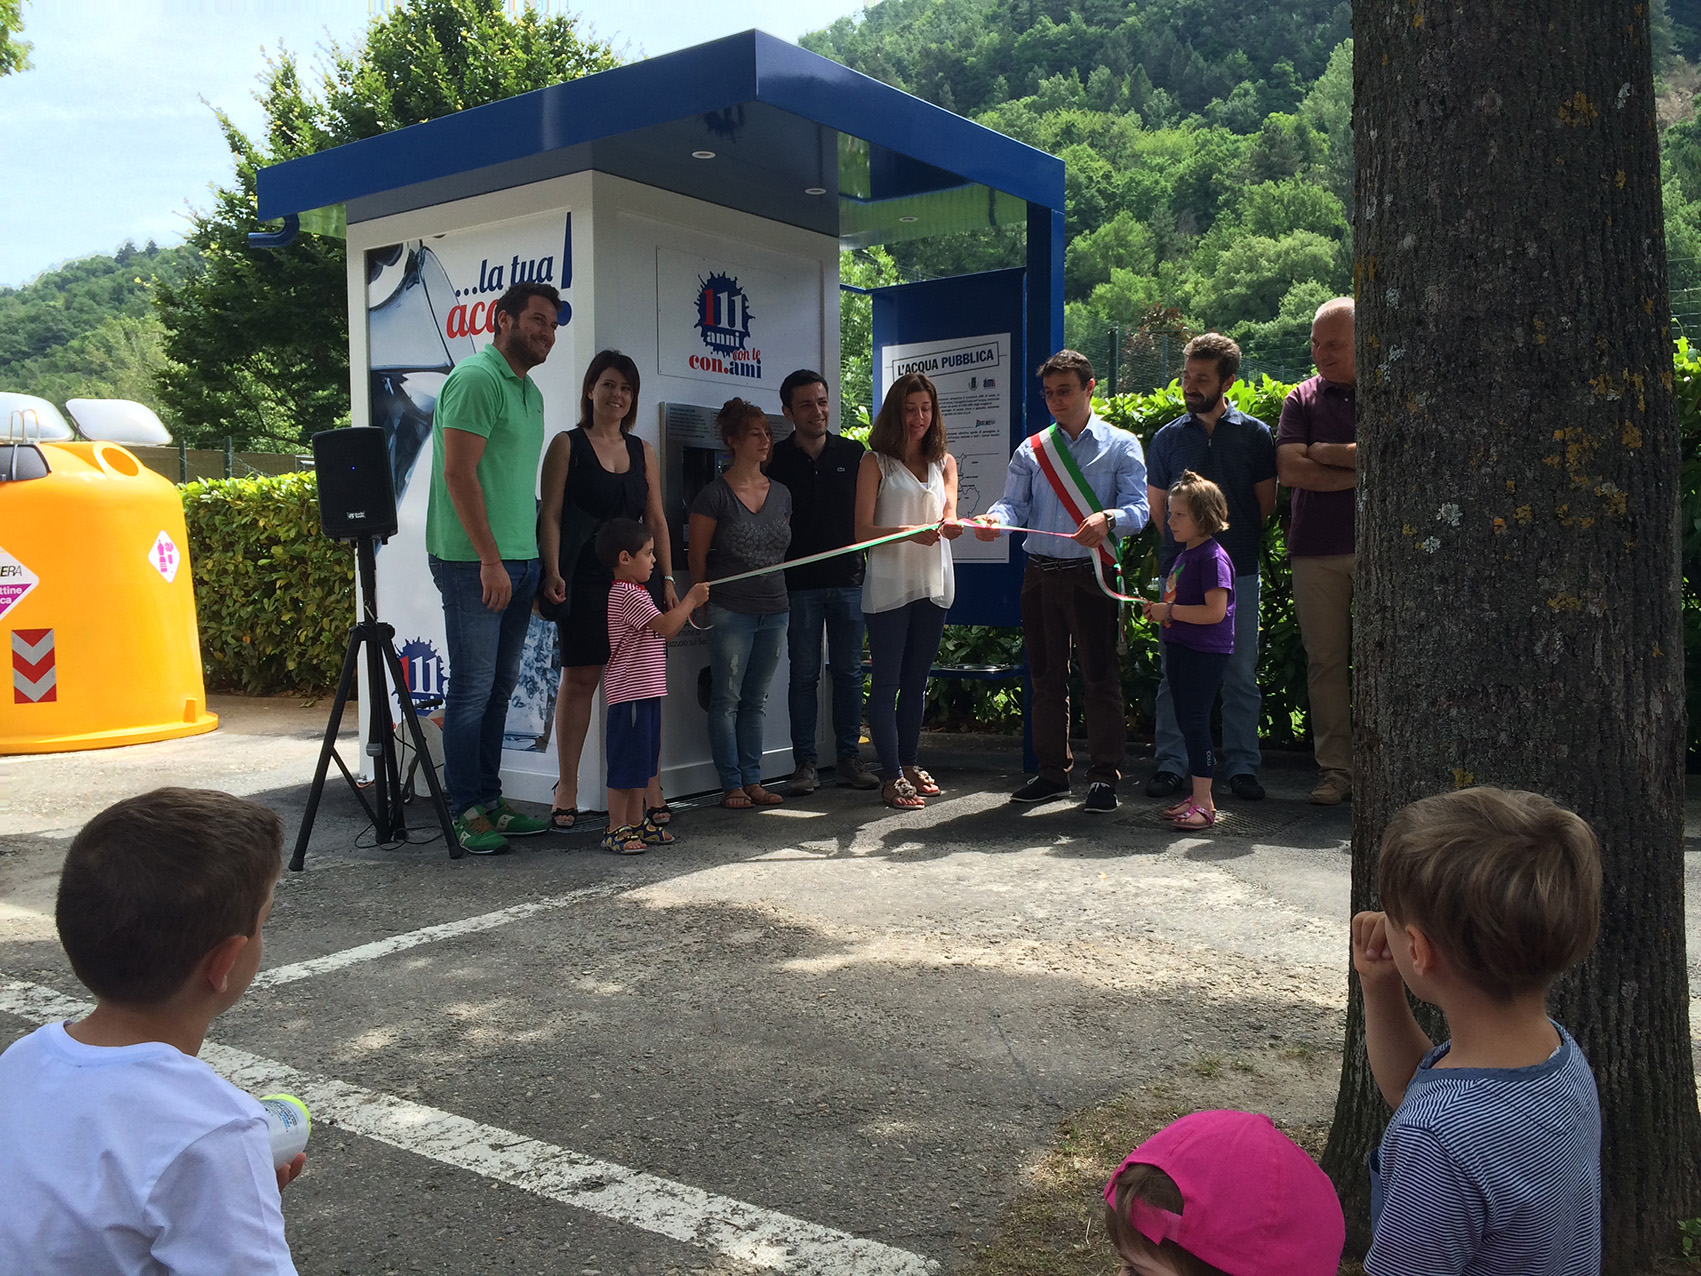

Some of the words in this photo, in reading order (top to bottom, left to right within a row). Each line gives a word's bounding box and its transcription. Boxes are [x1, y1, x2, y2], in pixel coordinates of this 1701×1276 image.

[510, 254, 554, 287] tua
[706, 331, 740, 348] anni
[732, 350, 750, 362] con
[897, 358, 939, 376] L'ACQUA
[941, 349, 994, 368] PUBBLICA
[688, 354, 762, 379] con.ami
[0, 565, 23, 577] ERA
[0, 586, 23, 595] ttine
